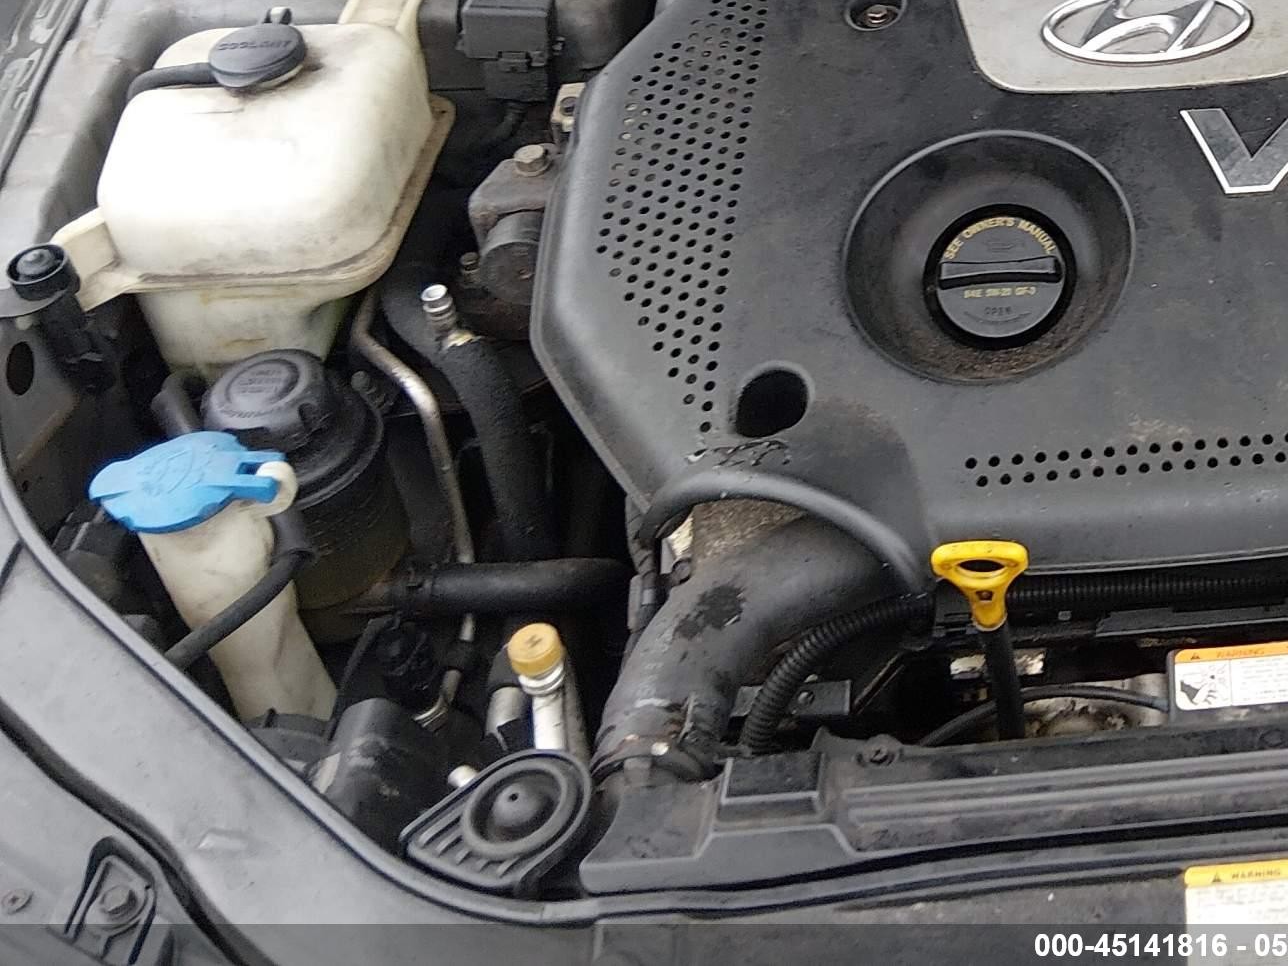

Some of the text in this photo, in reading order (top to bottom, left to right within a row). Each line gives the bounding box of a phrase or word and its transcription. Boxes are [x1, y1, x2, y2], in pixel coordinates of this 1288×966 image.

[217, 40, 293, 51] COOLANT
[944, 237, 964, 260] SEE
[1018, 219, 1056, 254] MANUAL
[1231, 868, 1281, 880] WARNING
